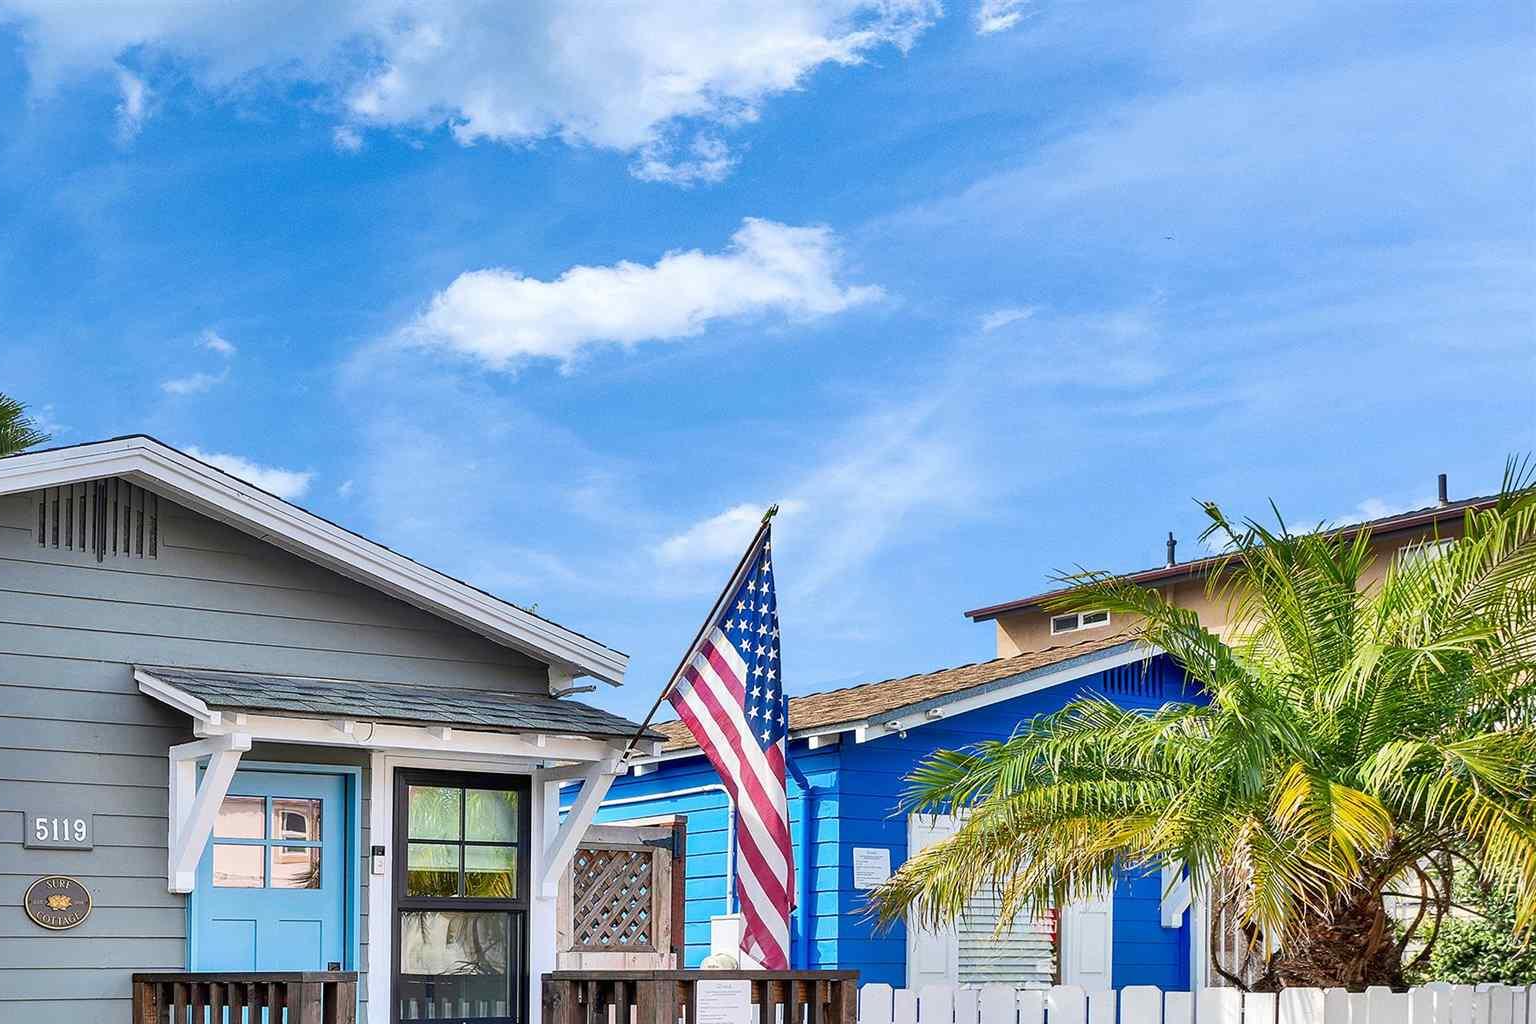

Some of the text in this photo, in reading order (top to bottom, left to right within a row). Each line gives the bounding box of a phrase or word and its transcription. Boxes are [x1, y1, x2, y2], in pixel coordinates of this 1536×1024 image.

[36, 818, 86, 841] 5119
[46, 880, 71, 889] SURF
[36, 911, 80, 926] COTTAGE
